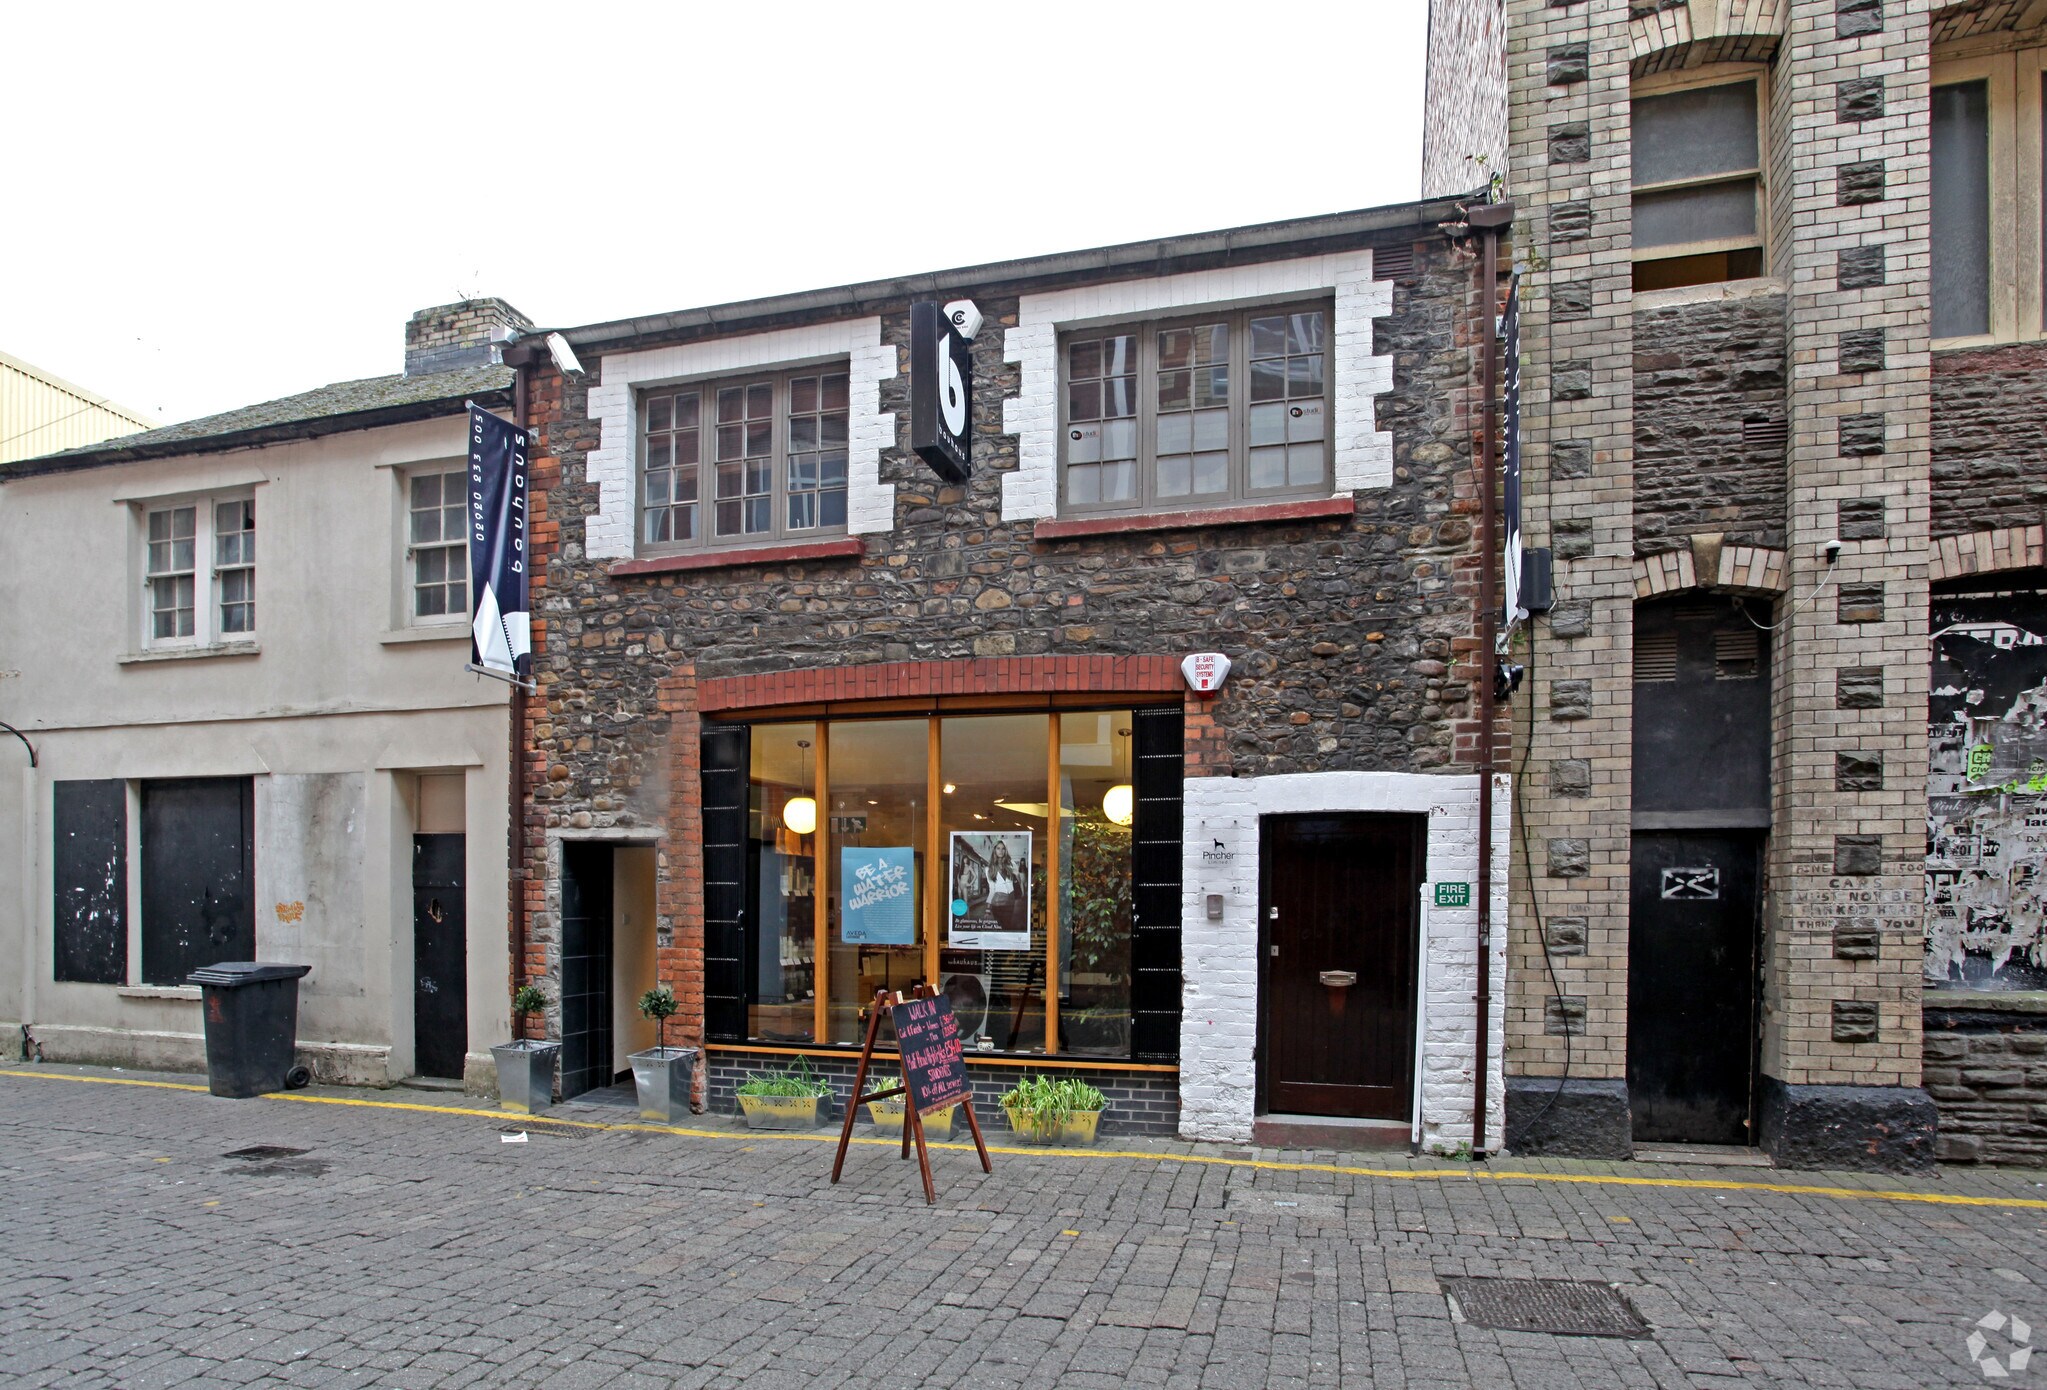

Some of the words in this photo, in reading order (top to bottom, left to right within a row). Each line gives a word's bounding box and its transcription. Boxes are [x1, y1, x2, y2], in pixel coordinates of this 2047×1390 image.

[474, 414, 484, 444] 005
[938, 423, 966, 461] bauhaus
[473, 453, 482, 483] 233
[511, 433, 525, 573] bauhaus
[474, 491, 485, 542] 02920
[1202, 851, 1235, 860] Pincher
[855, 863, 876, 880] BE
[878, 857, 888, 870] A
[853, 865, 908, 896] WATER
[1439, 884, 1466, 894] FIRE
[1829, 878, 1883, 889] CARS
[1439, 895, 1466, 904] EXIT
[1883, 919, 1915, 928] YOU
[907, 1003, 927, 1021] WALK
[927, 1000, 937, 1016] IN
